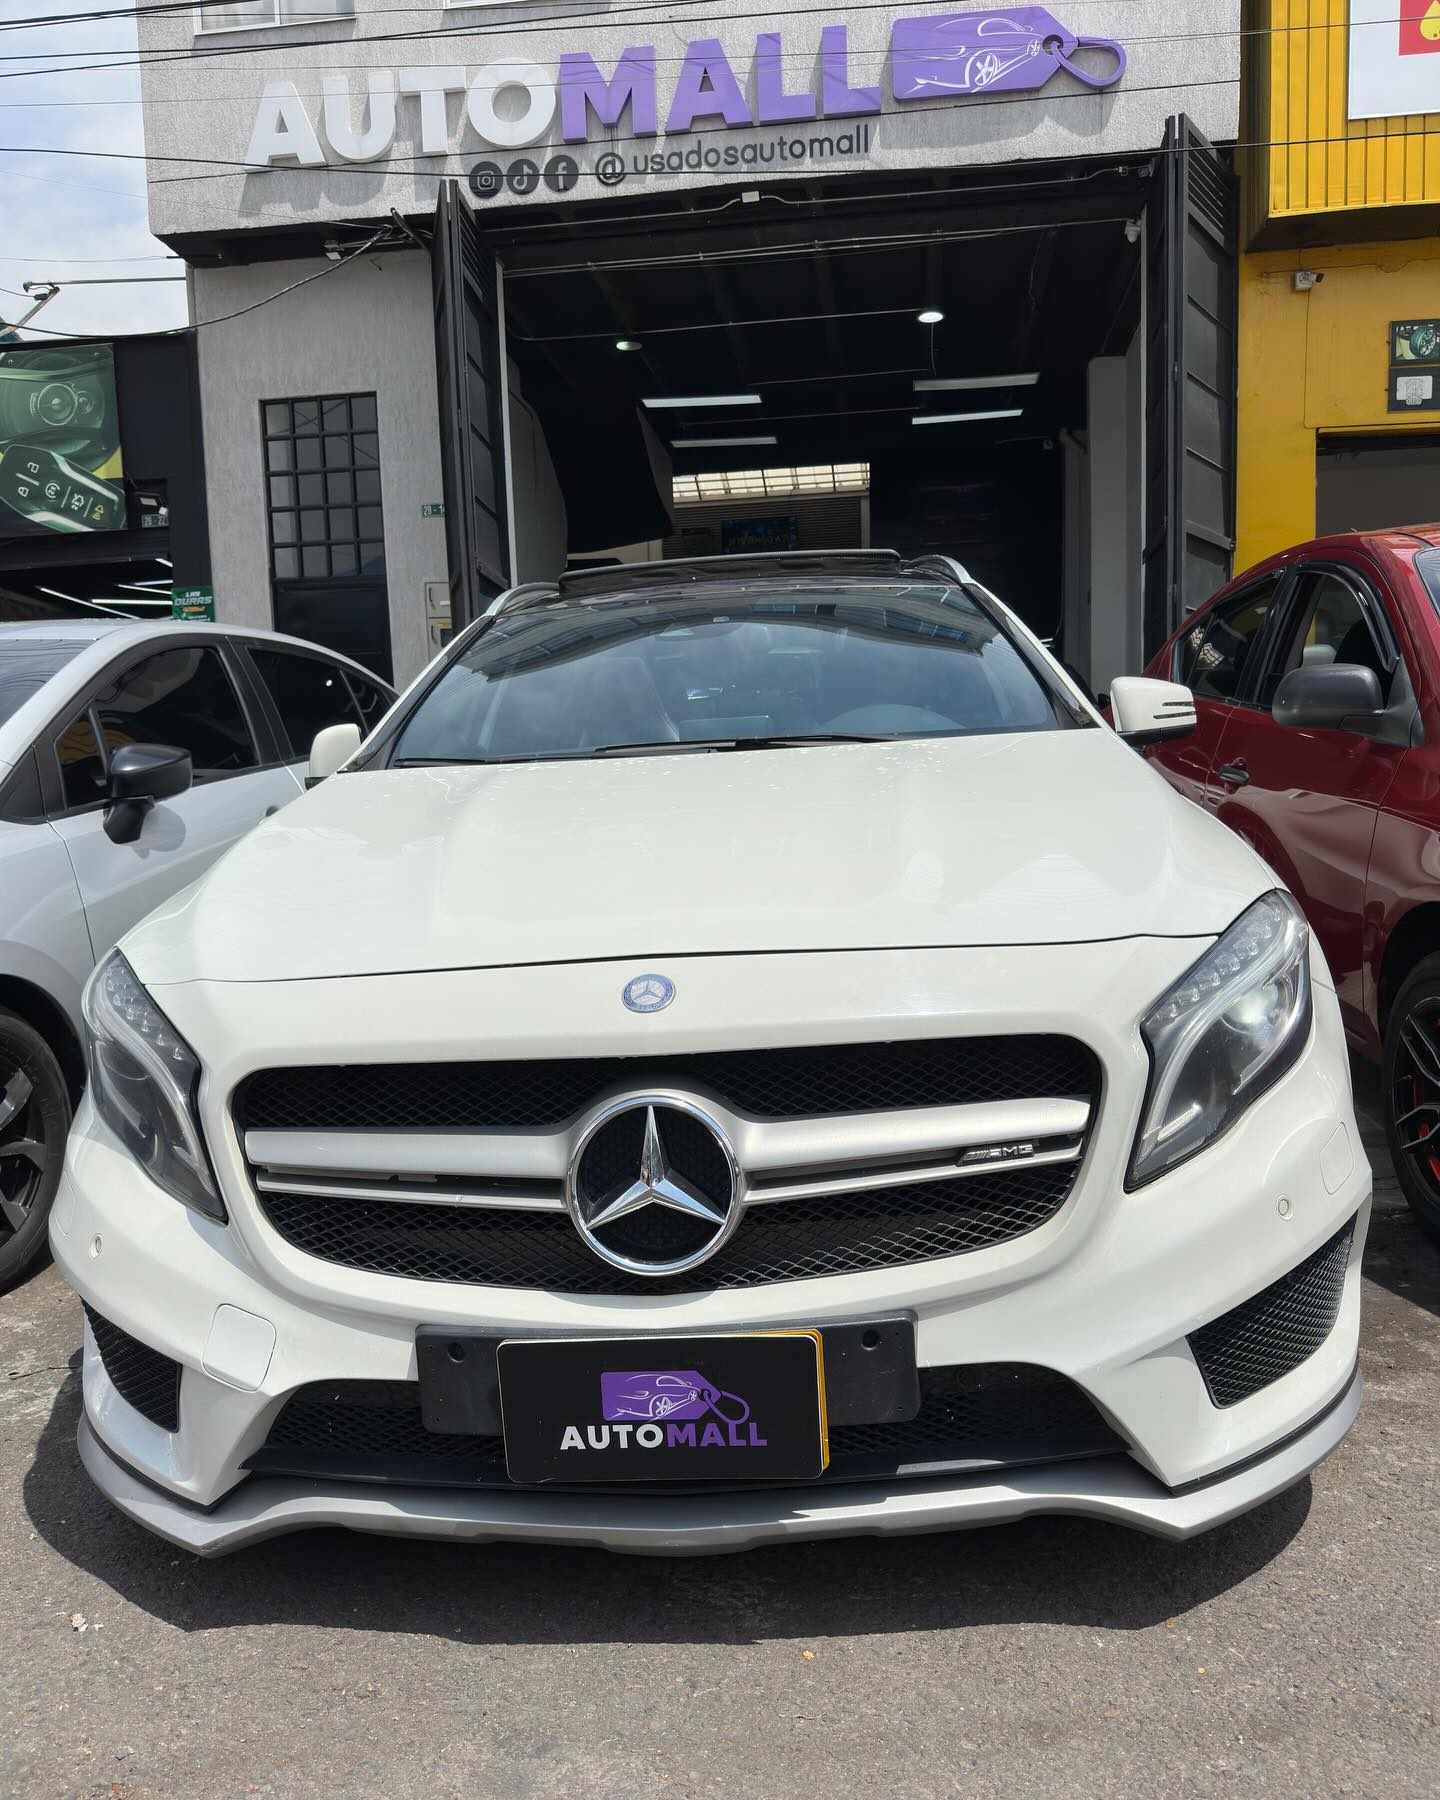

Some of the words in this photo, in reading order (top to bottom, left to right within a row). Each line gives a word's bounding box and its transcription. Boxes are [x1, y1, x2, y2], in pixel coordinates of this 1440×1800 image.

[245, 25, 881, 173] AUTOMALL
[986, 1144, 1034, 1158] AMG
[560, 1421, 768, 1451] AUTOMALL
